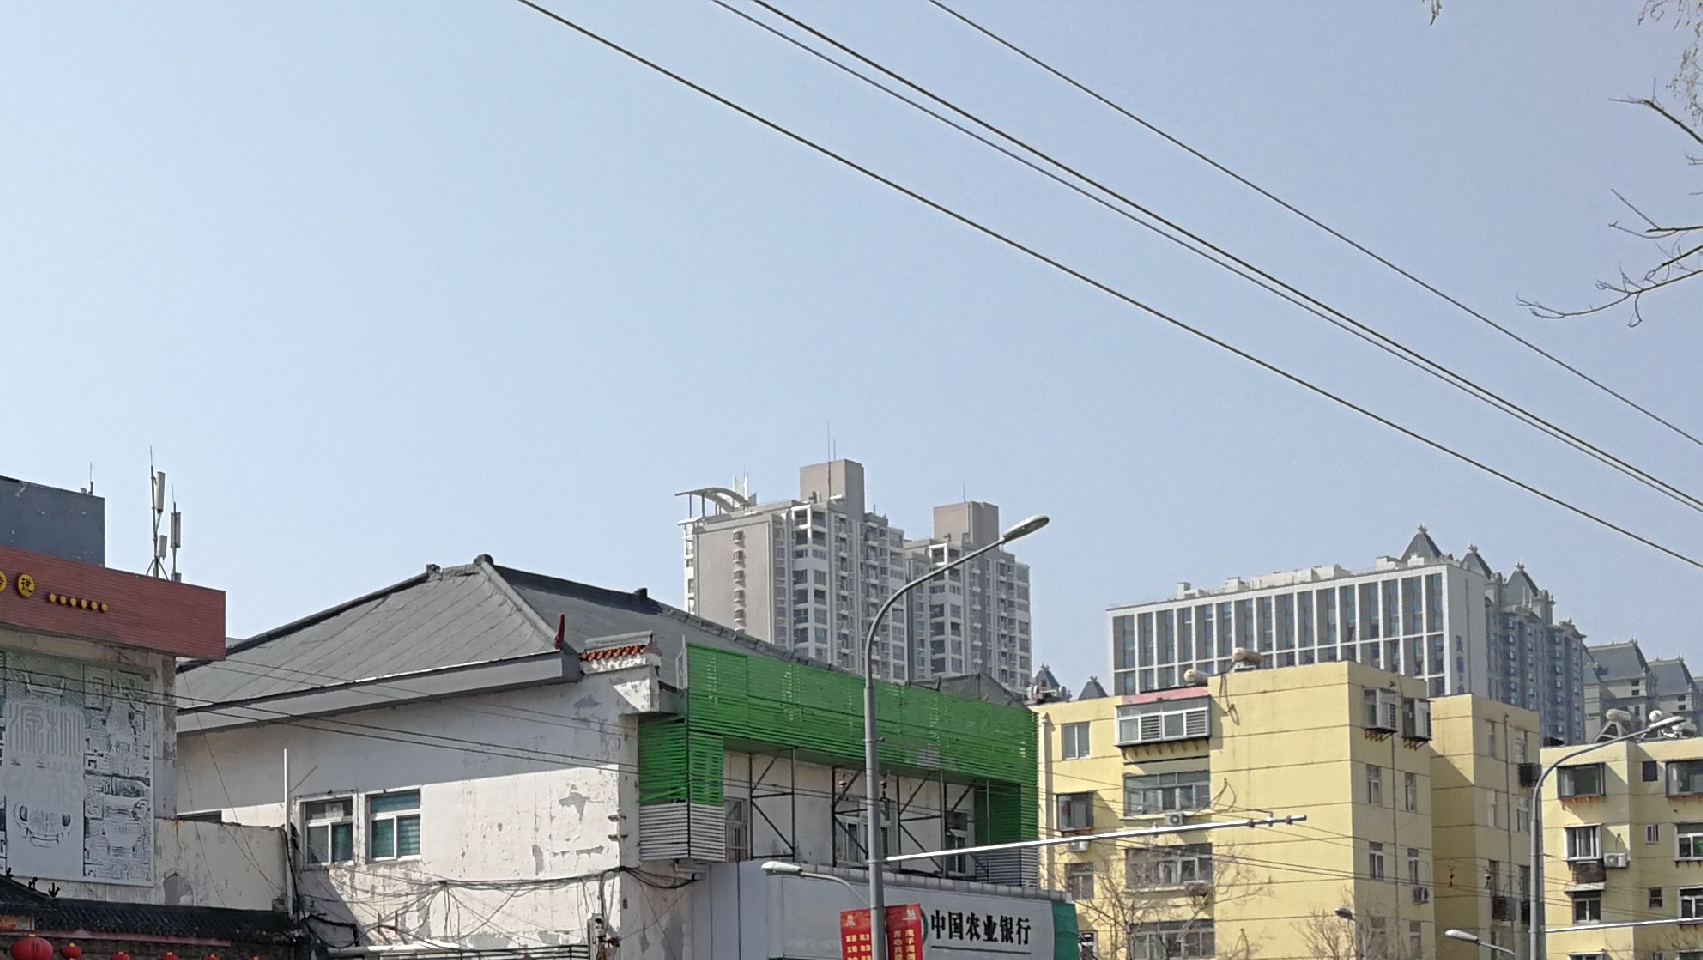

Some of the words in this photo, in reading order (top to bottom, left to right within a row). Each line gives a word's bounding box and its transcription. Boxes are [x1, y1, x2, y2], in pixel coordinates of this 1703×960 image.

[930, 909, 1032, 946] 中国农业银行
